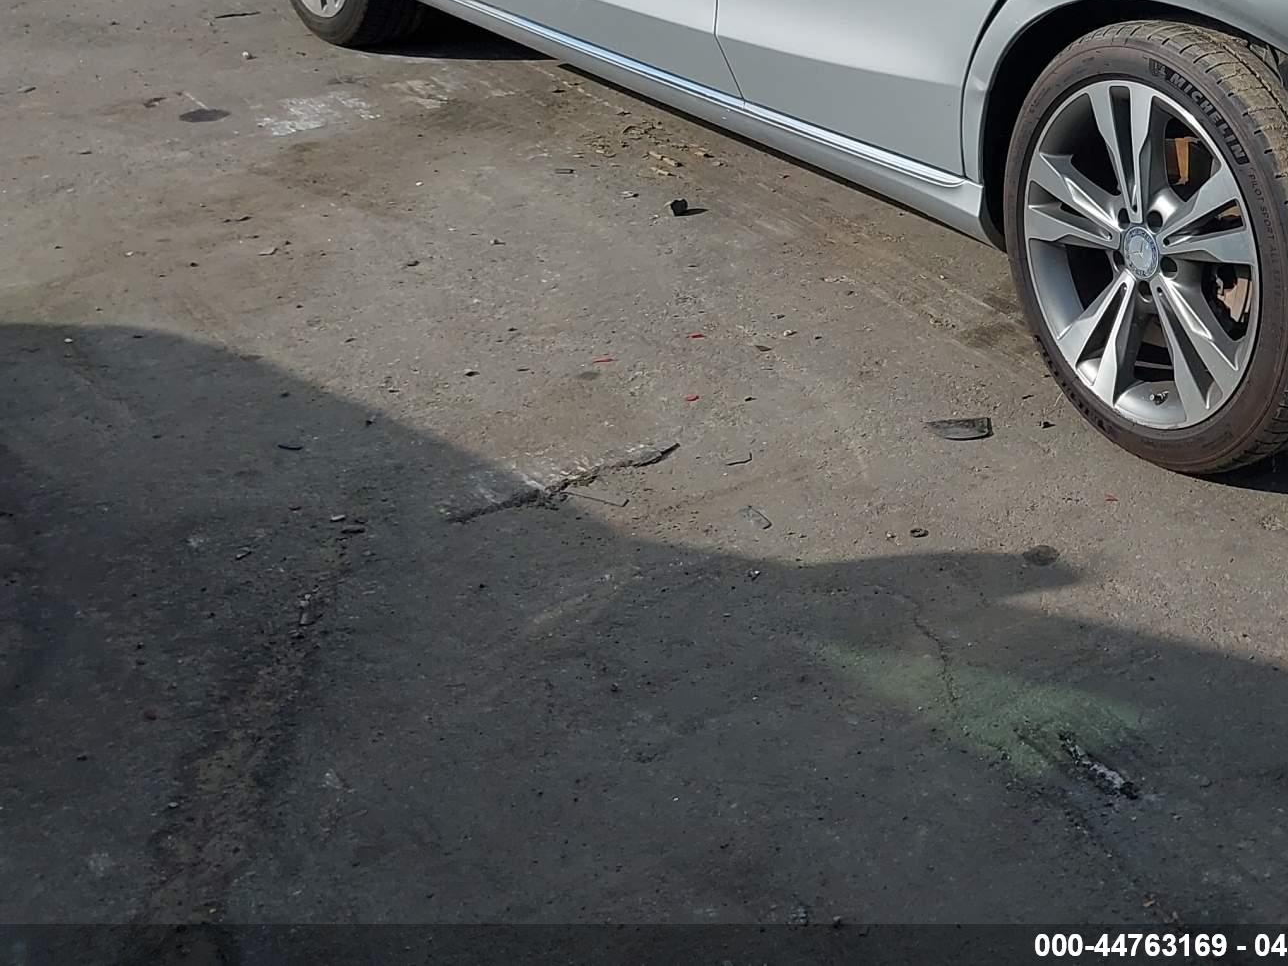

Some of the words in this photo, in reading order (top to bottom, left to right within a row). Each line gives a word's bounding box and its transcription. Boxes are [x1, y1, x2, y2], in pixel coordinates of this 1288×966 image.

[1169, 73, 1248, 161] MICHELIN
[1248, 173, 1265, 202] PILOT
[1260, 205, 1276, 241] SPORT
